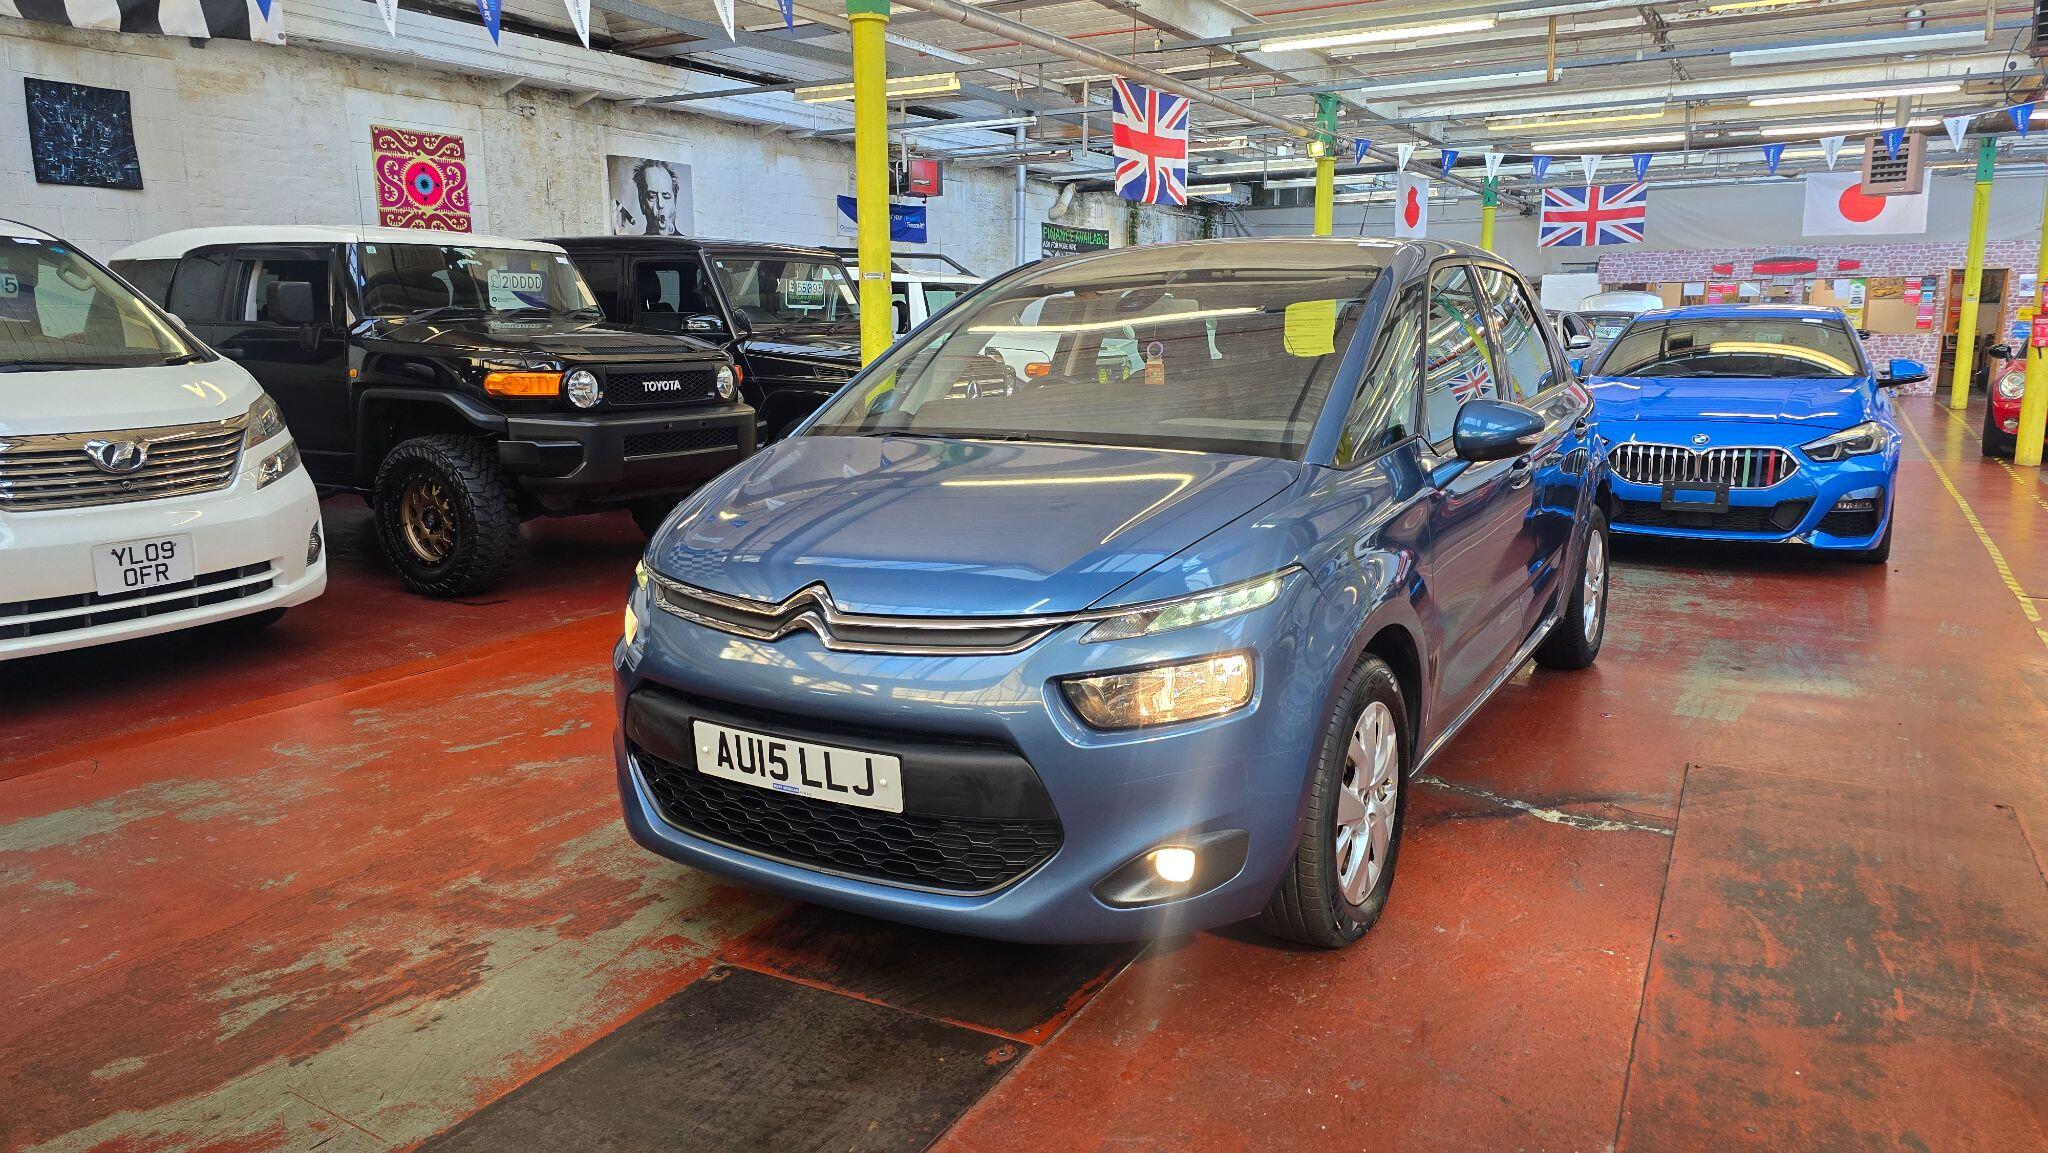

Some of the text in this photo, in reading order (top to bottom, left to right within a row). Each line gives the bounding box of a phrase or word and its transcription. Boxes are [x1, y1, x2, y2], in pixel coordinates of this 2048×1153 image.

[1043, 226, 1108, 246] FINANCE AVAILABLE
[642, 380, 682, 392] TOYOTA
[111, 540, 175, 567] YL09
[123, 562, 170, 587] OFR
[717, 730, 875, 797] AU15 LLJ
